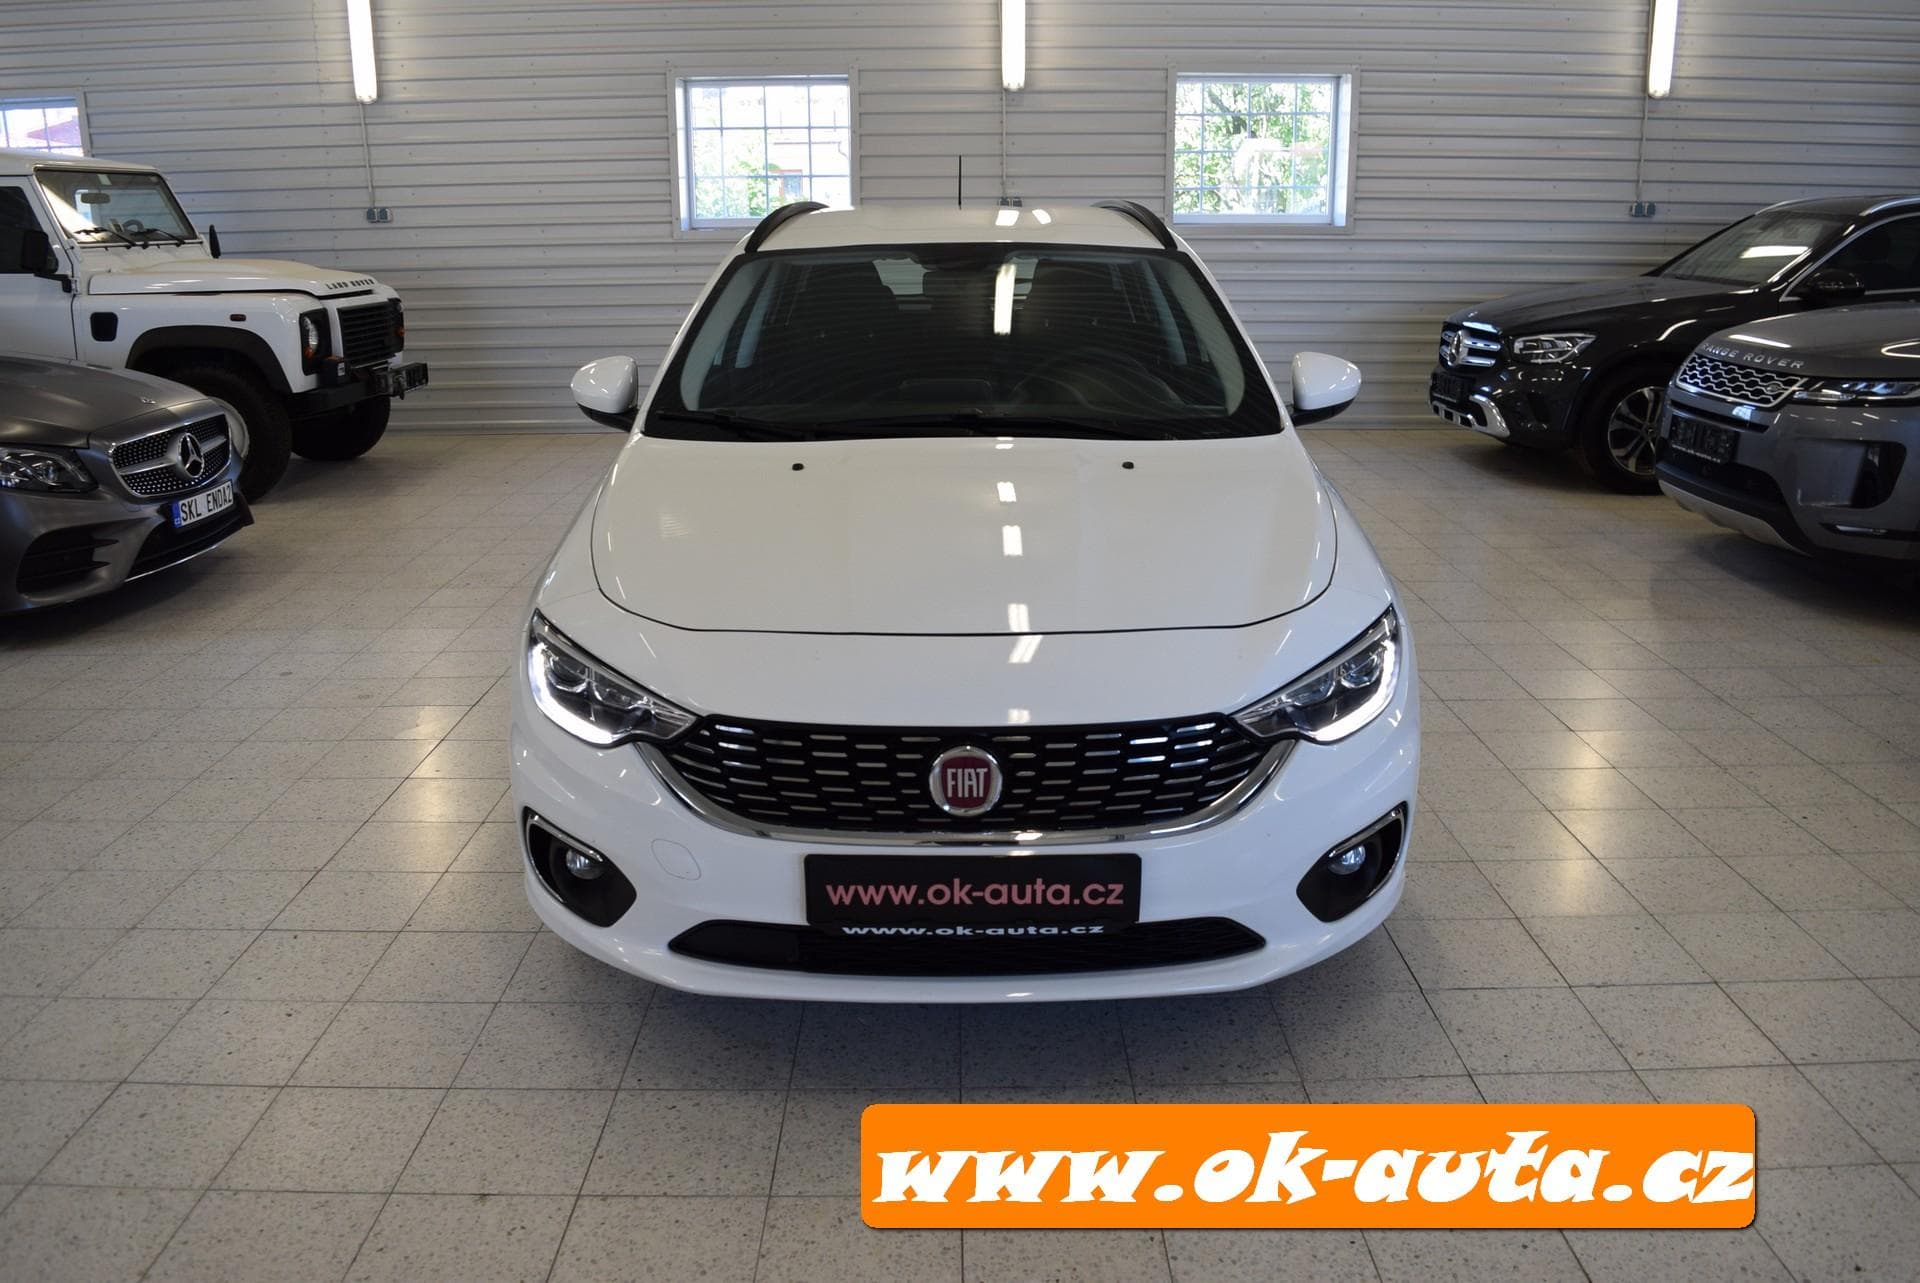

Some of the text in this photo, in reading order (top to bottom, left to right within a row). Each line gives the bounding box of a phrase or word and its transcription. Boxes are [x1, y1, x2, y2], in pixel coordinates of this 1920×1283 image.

[325, 278, 375, 290] LAND ROVER
[1702, 343, 1804, 369] RANGE ROVER
[181, 498, 202, 522] SKL
[946, 767, 988, 798] FIAT
[826, 878, 1125, 906] www.ok-auta.cz
[842, 924, 1105, 936] www.ok-auta.cz
